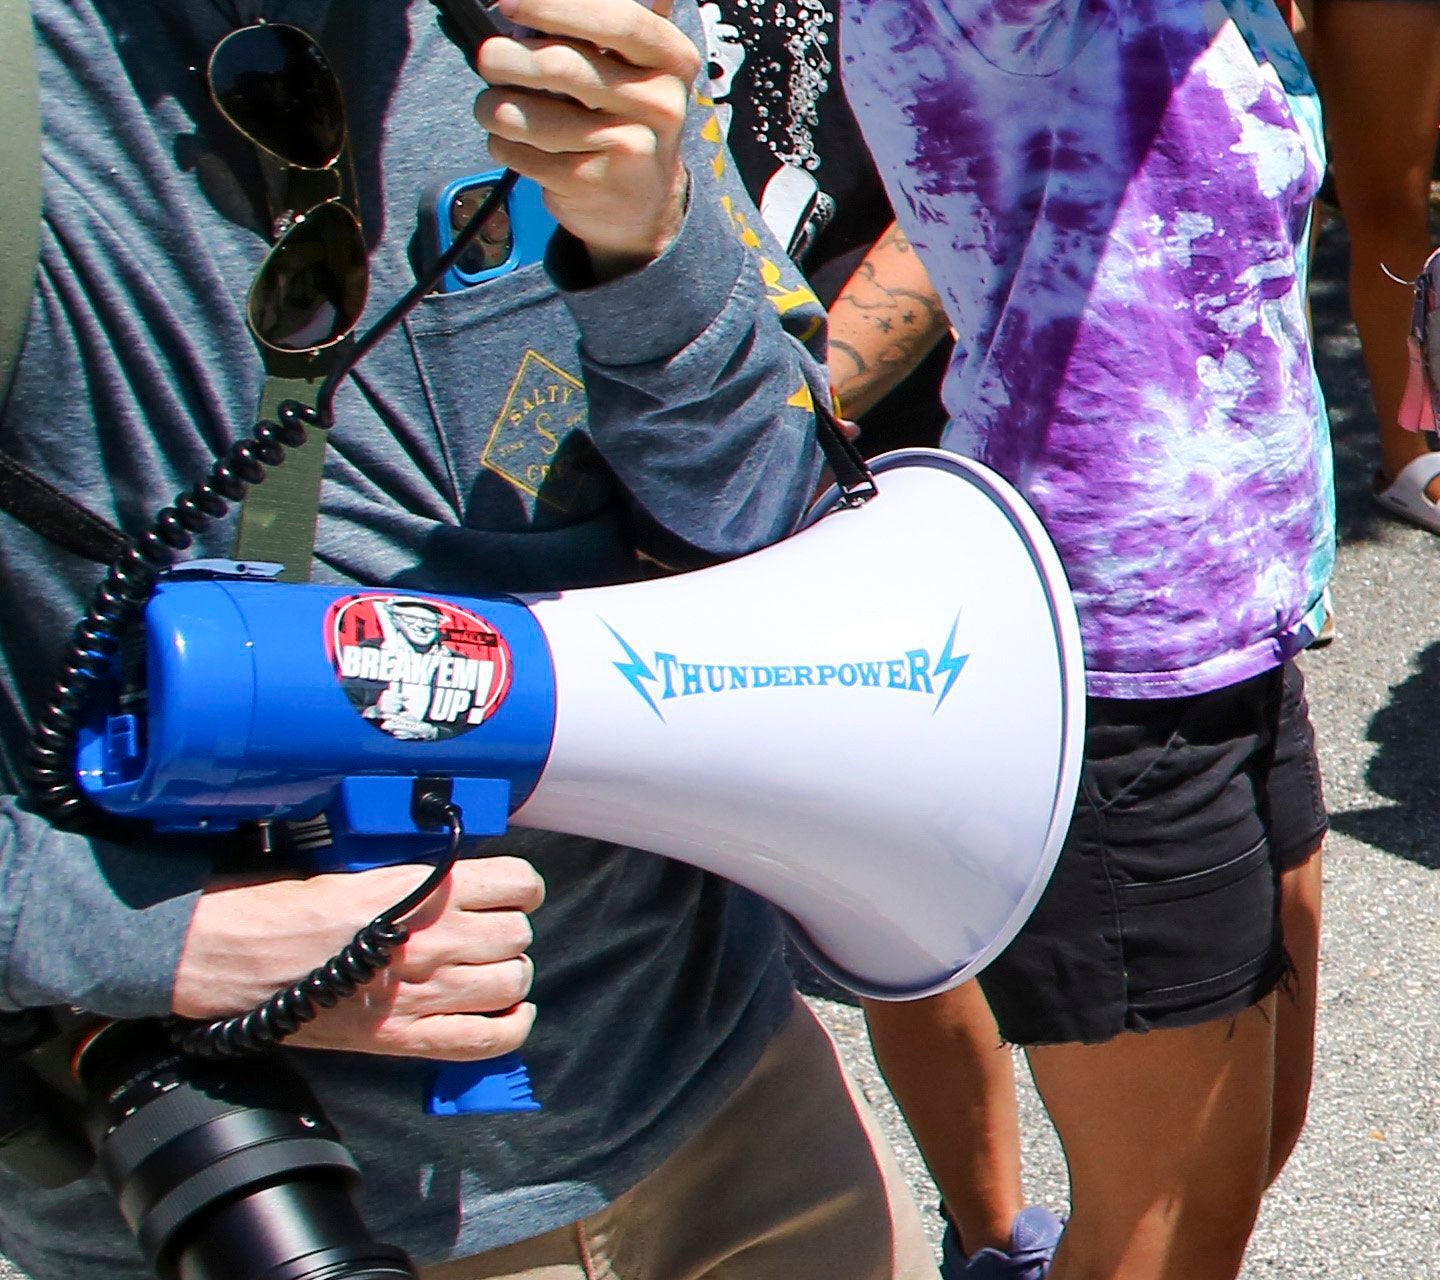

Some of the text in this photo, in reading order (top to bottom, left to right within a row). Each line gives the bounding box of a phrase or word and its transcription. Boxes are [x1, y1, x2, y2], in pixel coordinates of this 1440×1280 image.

[508, 384, 574, 426] SALTY
[341, 646, 433, 686] BREAK
[654, 648, 936, 701] THUNDERPOWER
